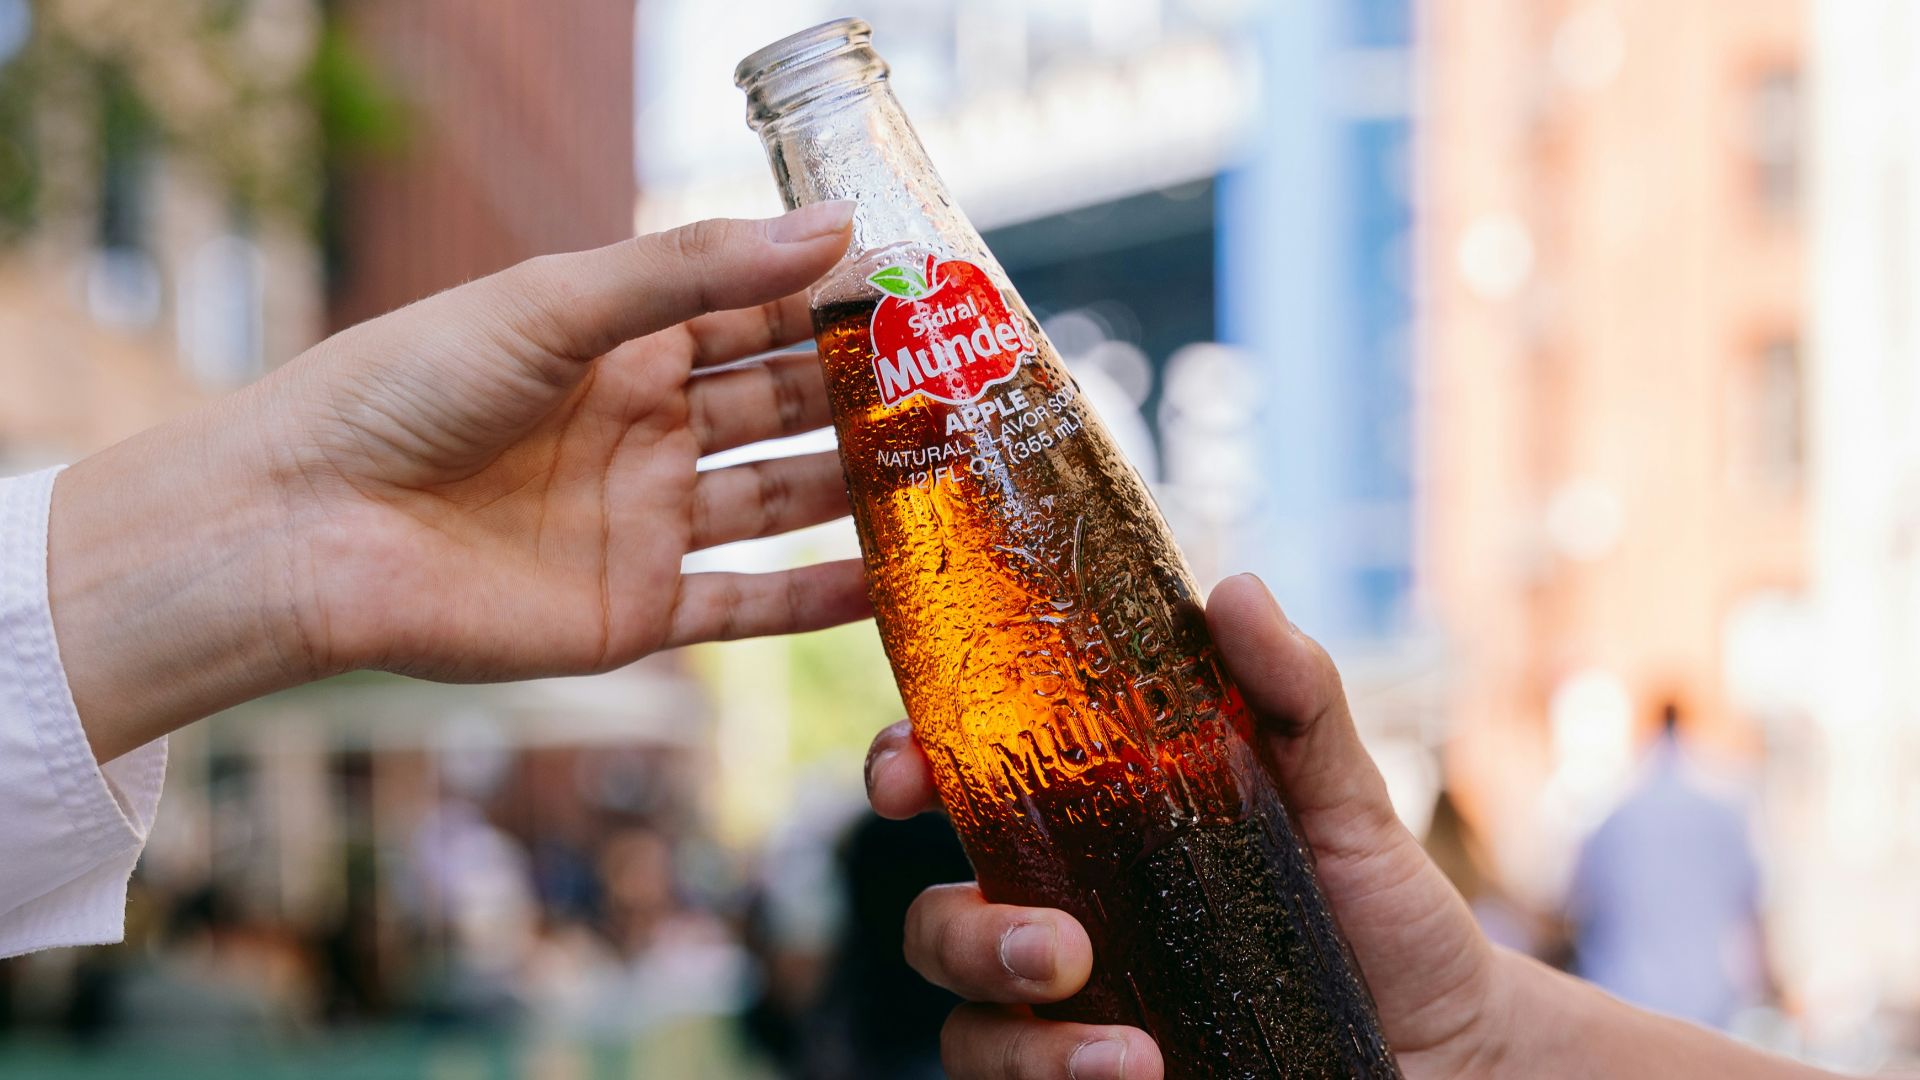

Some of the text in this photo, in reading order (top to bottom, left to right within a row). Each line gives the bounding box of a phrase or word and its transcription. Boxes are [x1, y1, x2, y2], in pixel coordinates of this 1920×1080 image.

[907, 295, 979, 337] Sidral
[877, 315, 1032, 399] Mundet
[877, 385, 1075, 468] NATURAL FLAVOR SOD
[908, 410, 1083, 489] 12 FL OZ (355 mL)
[945, 388, 1030, 436] APPLE
